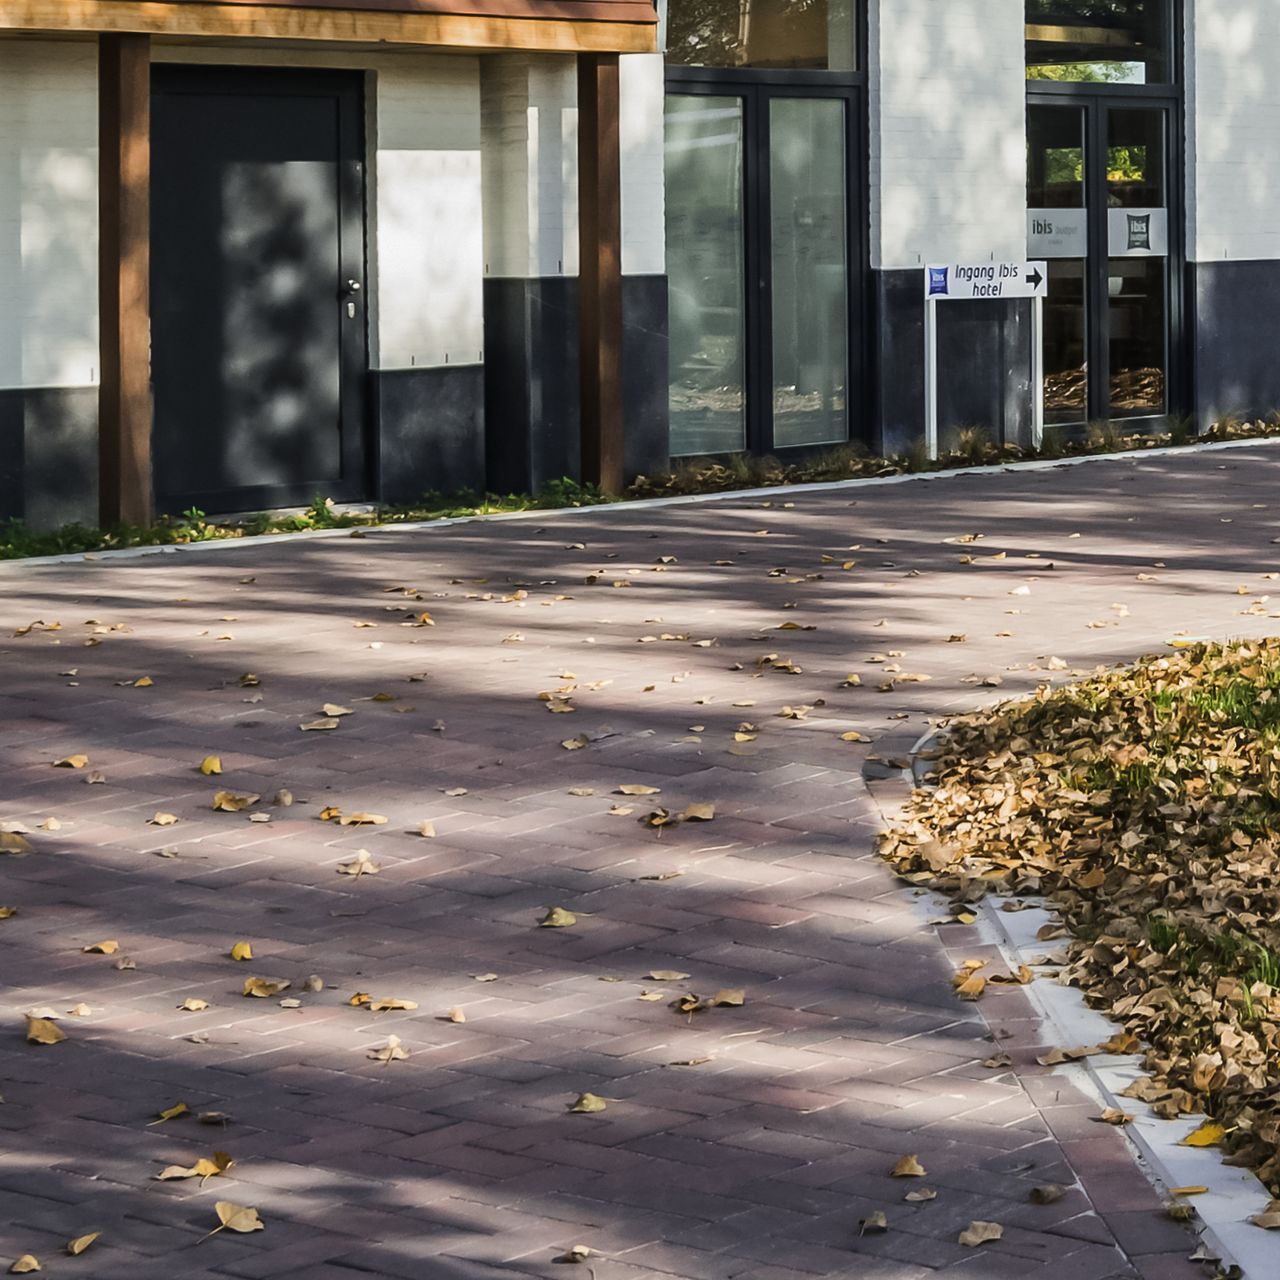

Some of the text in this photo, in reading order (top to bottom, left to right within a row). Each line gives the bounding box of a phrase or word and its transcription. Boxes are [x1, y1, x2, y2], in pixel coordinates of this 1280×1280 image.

[1032, 219, 1053, 235] ibis
[955, 263, 1018, 282] Ingang Ibis
[972, 282, 1002, 297] hotel
